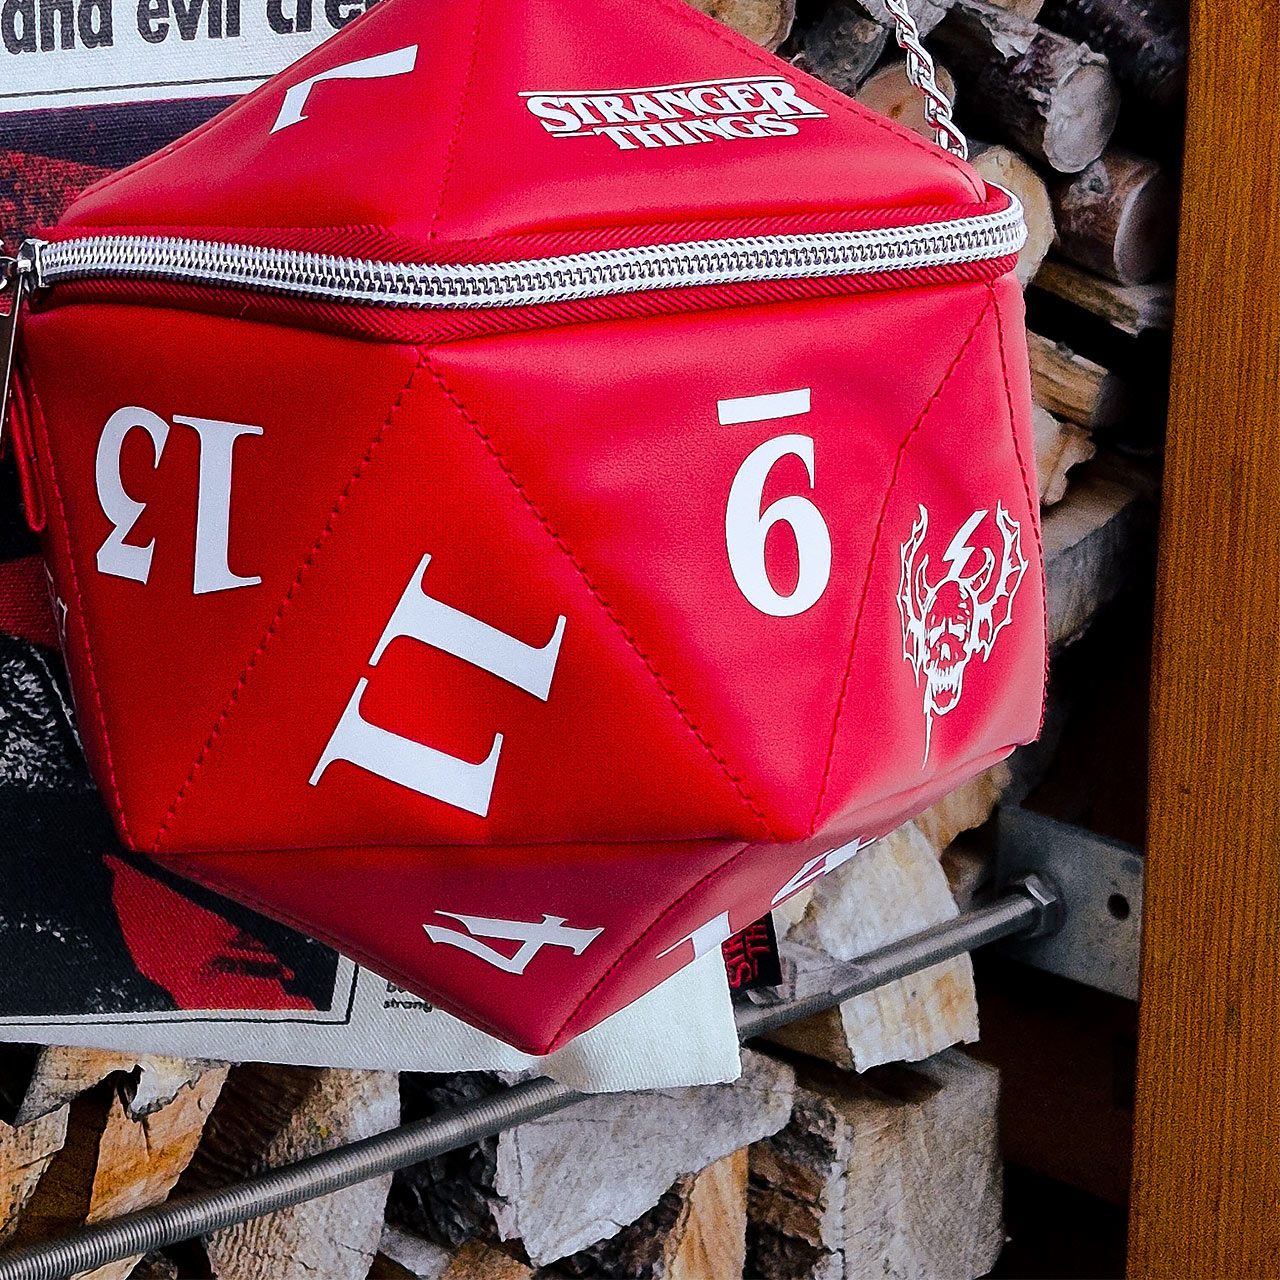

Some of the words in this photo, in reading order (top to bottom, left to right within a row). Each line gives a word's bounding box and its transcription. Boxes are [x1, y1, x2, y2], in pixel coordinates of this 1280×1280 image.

[526, 81, 824, 133] STRANGER
[594, 114, 800, 150] THINGS
[94, 404, 264, 596] 13
[308, 552, 567, 818] 11
